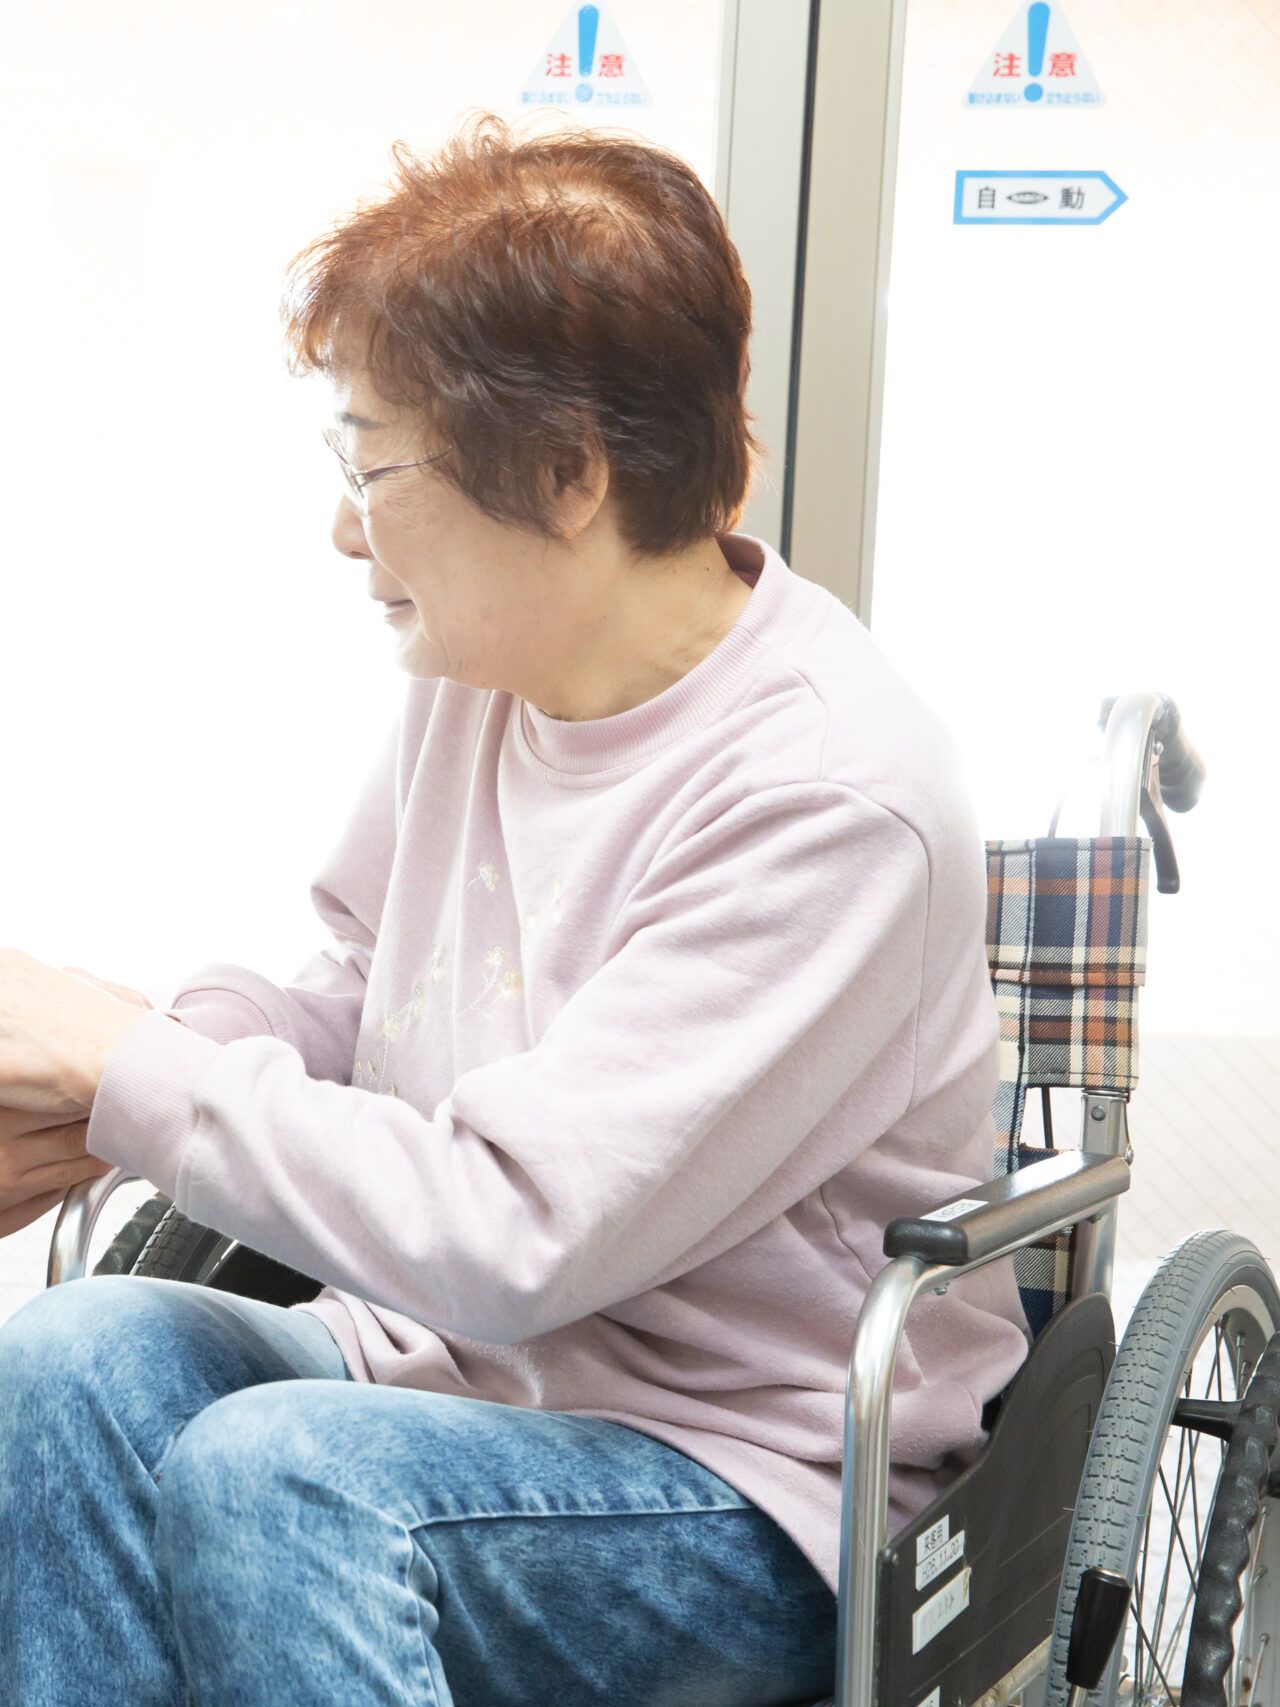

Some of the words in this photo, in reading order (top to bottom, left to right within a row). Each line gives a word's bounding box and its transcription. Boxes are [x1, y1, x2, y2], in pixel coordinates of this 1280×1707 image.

[546, 53, 572, 77] 注
[598, 53, 625, 78] 意
[993, 52, 1021, 77] 注
[1049, 52, 1076, 77] 意
[977, 186, 996, 209] 自
[1059, 186, 1085, 209] 動
